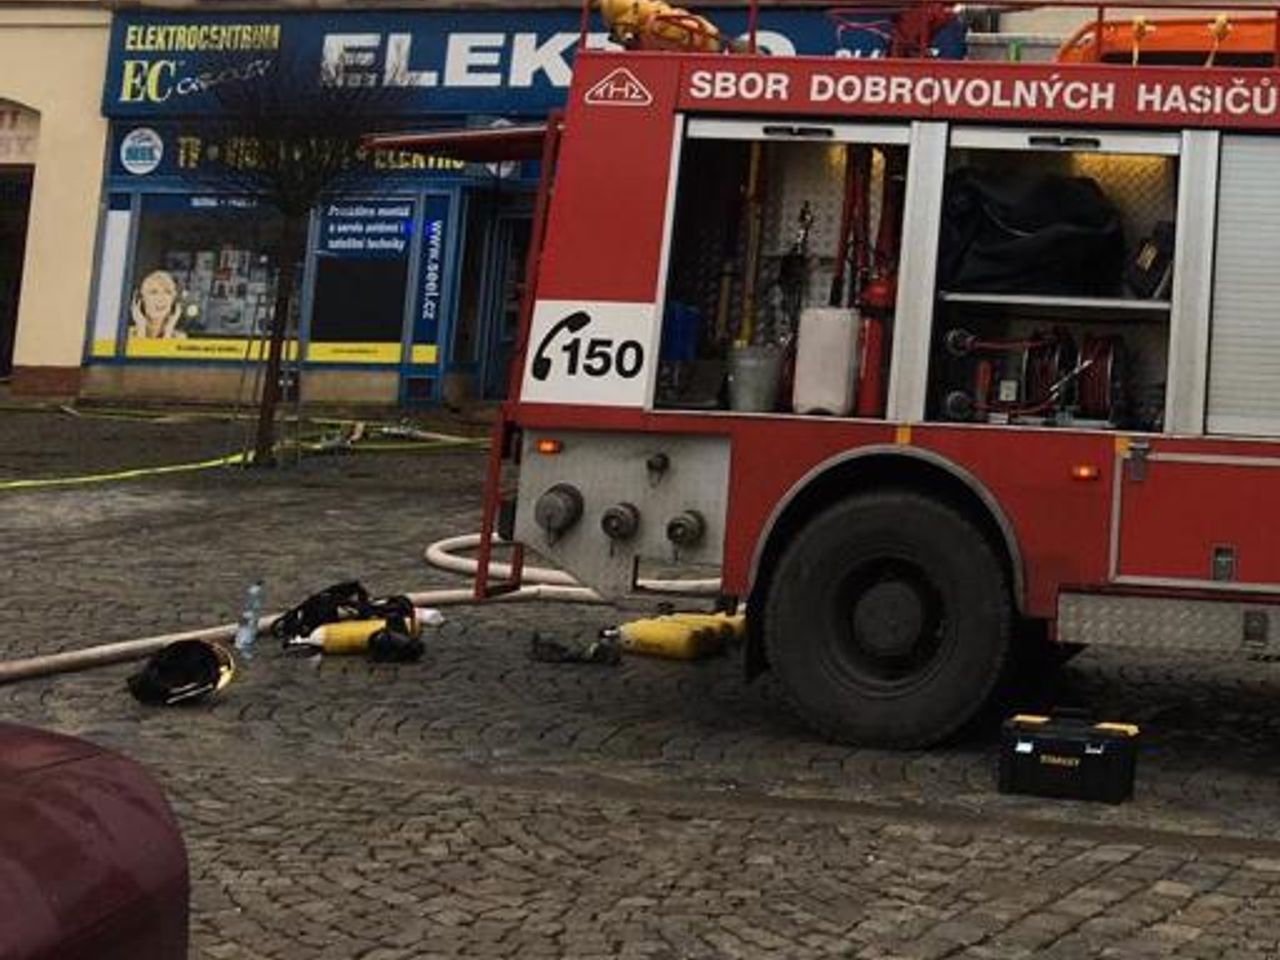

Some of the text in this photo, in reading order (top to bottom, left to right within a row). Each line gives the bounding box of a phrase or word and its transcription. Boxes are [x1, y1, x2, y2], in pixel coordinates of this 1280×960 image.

[119, 59, 177, 102] EC
[689, 71, 790, 101] SBOR
[810, 74, 1115, 109] DOBROVOLNÝCH
[1137, 77, 1278, 114] HASIČŮ
[562, 339, 644, 380] 150
